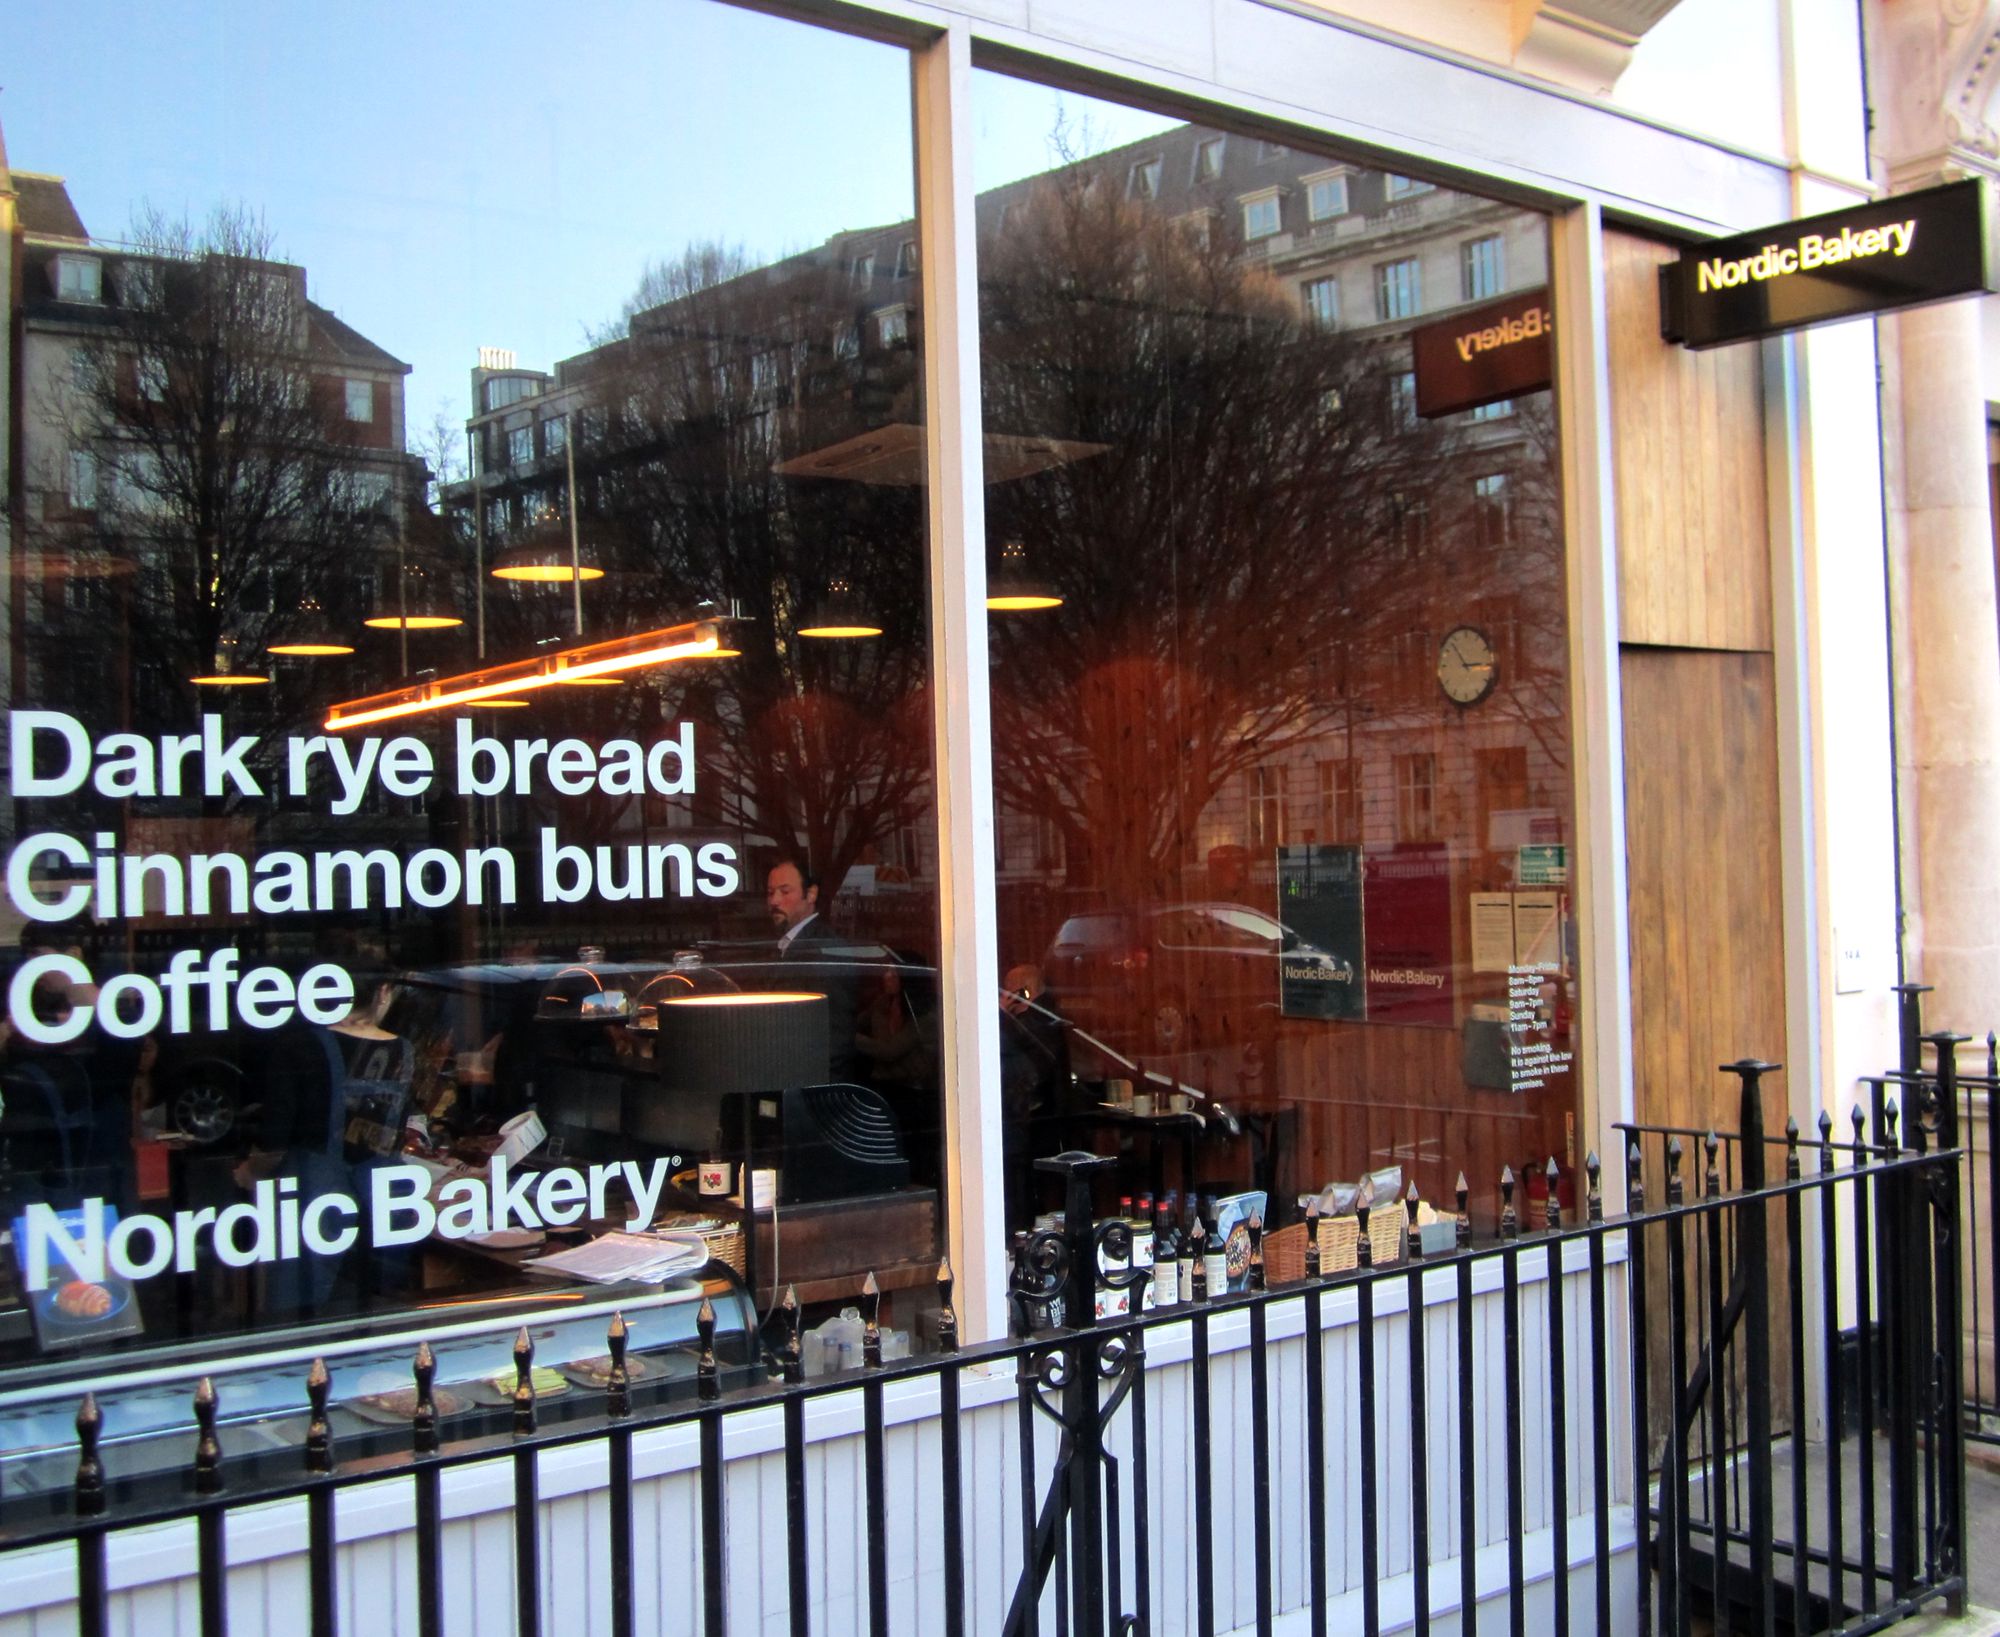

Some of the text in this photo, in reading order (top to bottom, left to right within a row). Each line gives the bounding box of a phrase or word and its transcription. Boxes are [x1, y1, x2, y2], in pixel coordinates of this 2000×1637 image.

[1698, 219, 1916, 293] Nordic Bakery
[9, 710, 696, 815] Dark rye bread
[7, 827, 740, 923] Cinnamon buns
[1285, 965, 1354, 985] Nordic Bakery
[1370, 968, 1445, 989] Nordic Bakery
[9, 948, 355, 1044] Coffee
[1509, 987, 1540, 998] Saturday
[1510, 1010, 1536, 1021] Sunday
[1511, 1046, 1522, 1056] No
[1524, 1054, 1549, 1067] against
[1549, 1053, 1561, 1063] the
[1511, 1070, 1520, 1080] to
[1520, 1067, 1543, 1078] smoke
[1550, 1064, 1569, 1074] these
[24, 1177, 360, 1291] Nordic
